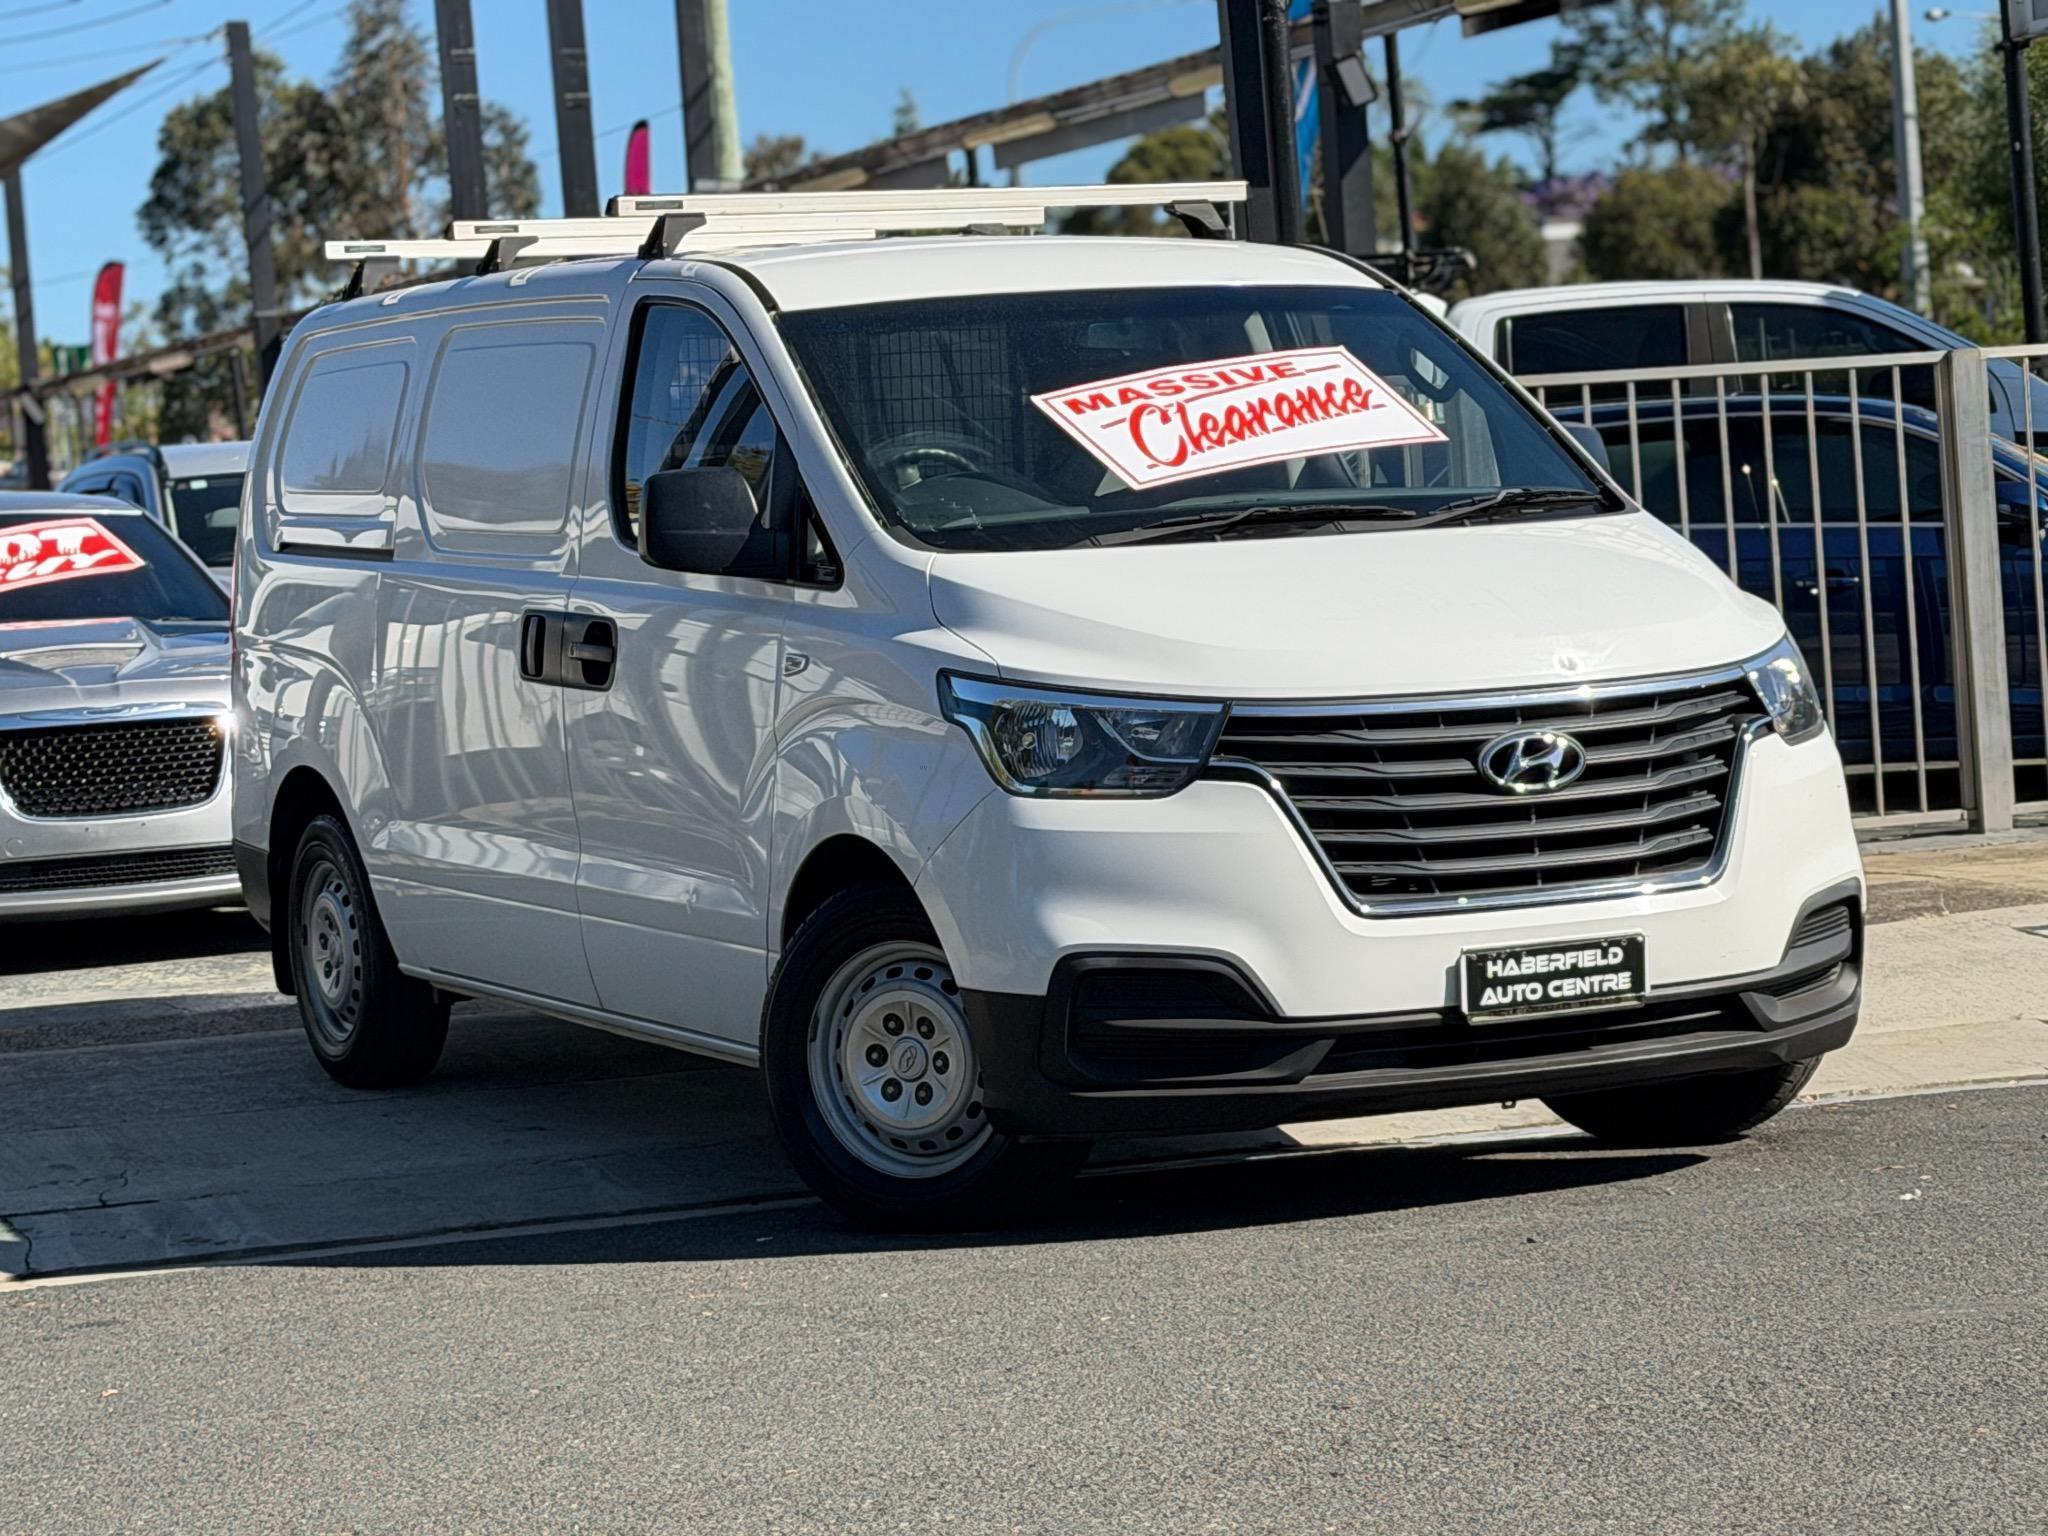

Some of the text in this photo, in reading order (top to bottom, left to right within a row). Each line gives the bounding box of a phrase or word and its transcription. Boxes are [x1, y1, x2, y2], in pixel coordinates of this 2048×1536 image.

[1063, 361, 1308, 415] MASSIVE
[1128, 375, 1374, 467] Clearance
[1486, 947, 1624, 978] HABERFIELD
[1480, 971, 1632, 1006] AUTO CENTRE
